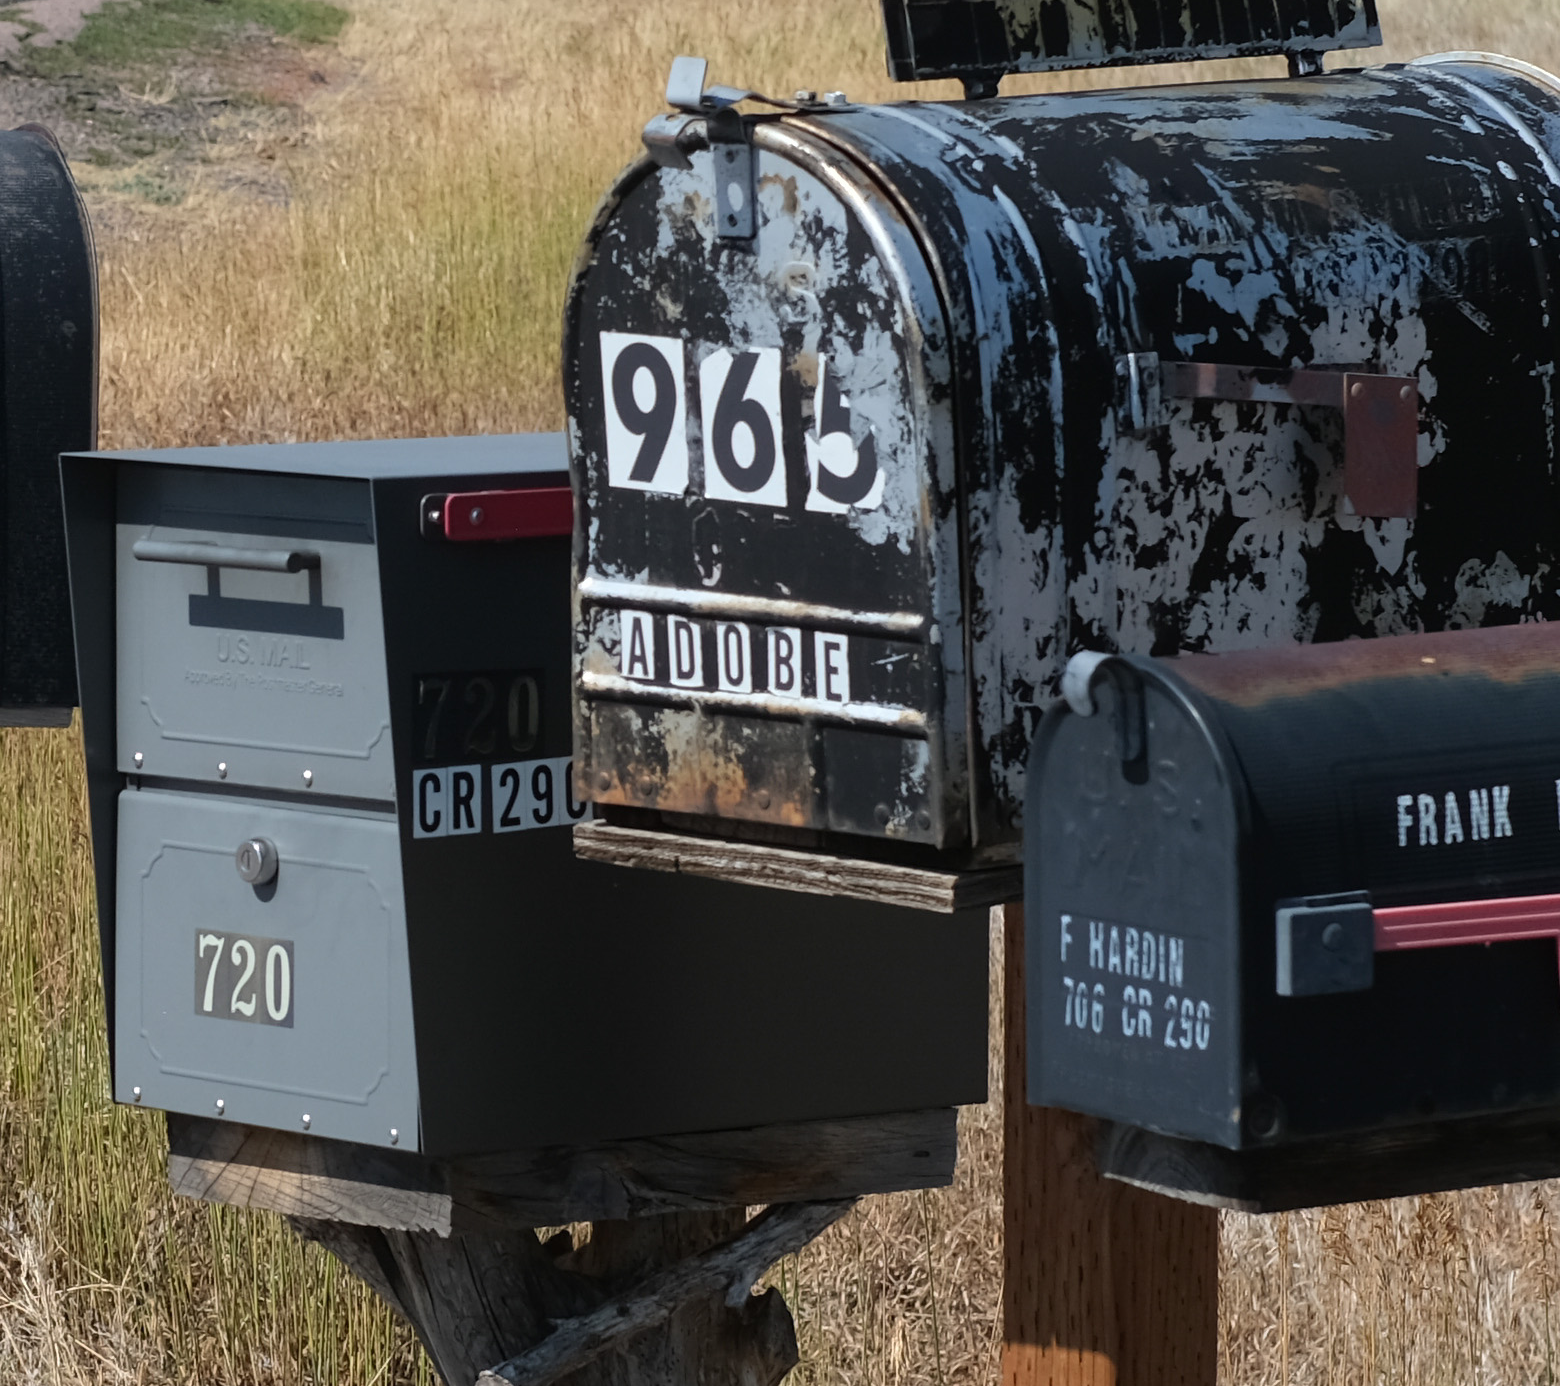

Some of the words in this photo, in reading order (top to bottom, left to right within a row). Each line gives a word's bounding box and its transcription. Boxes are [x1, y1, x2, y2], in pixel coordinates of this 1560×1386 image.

[627, 615, 843, 703] ADOBE
[418, 675, 540, 759] 720
[419, 771, 476, 834] CR
[1396, 785, 1514, 847] FRANK
[199, 933, 291, 1021] 720
[1060, 914, 1073, 963] F
[1089, 921, 1184, 988] HARDIN
[1063, 976, 1106, 1034] 706
[1121, 984, 1153, 1039] CR
[1163, 994, 1212, 1051] 290
